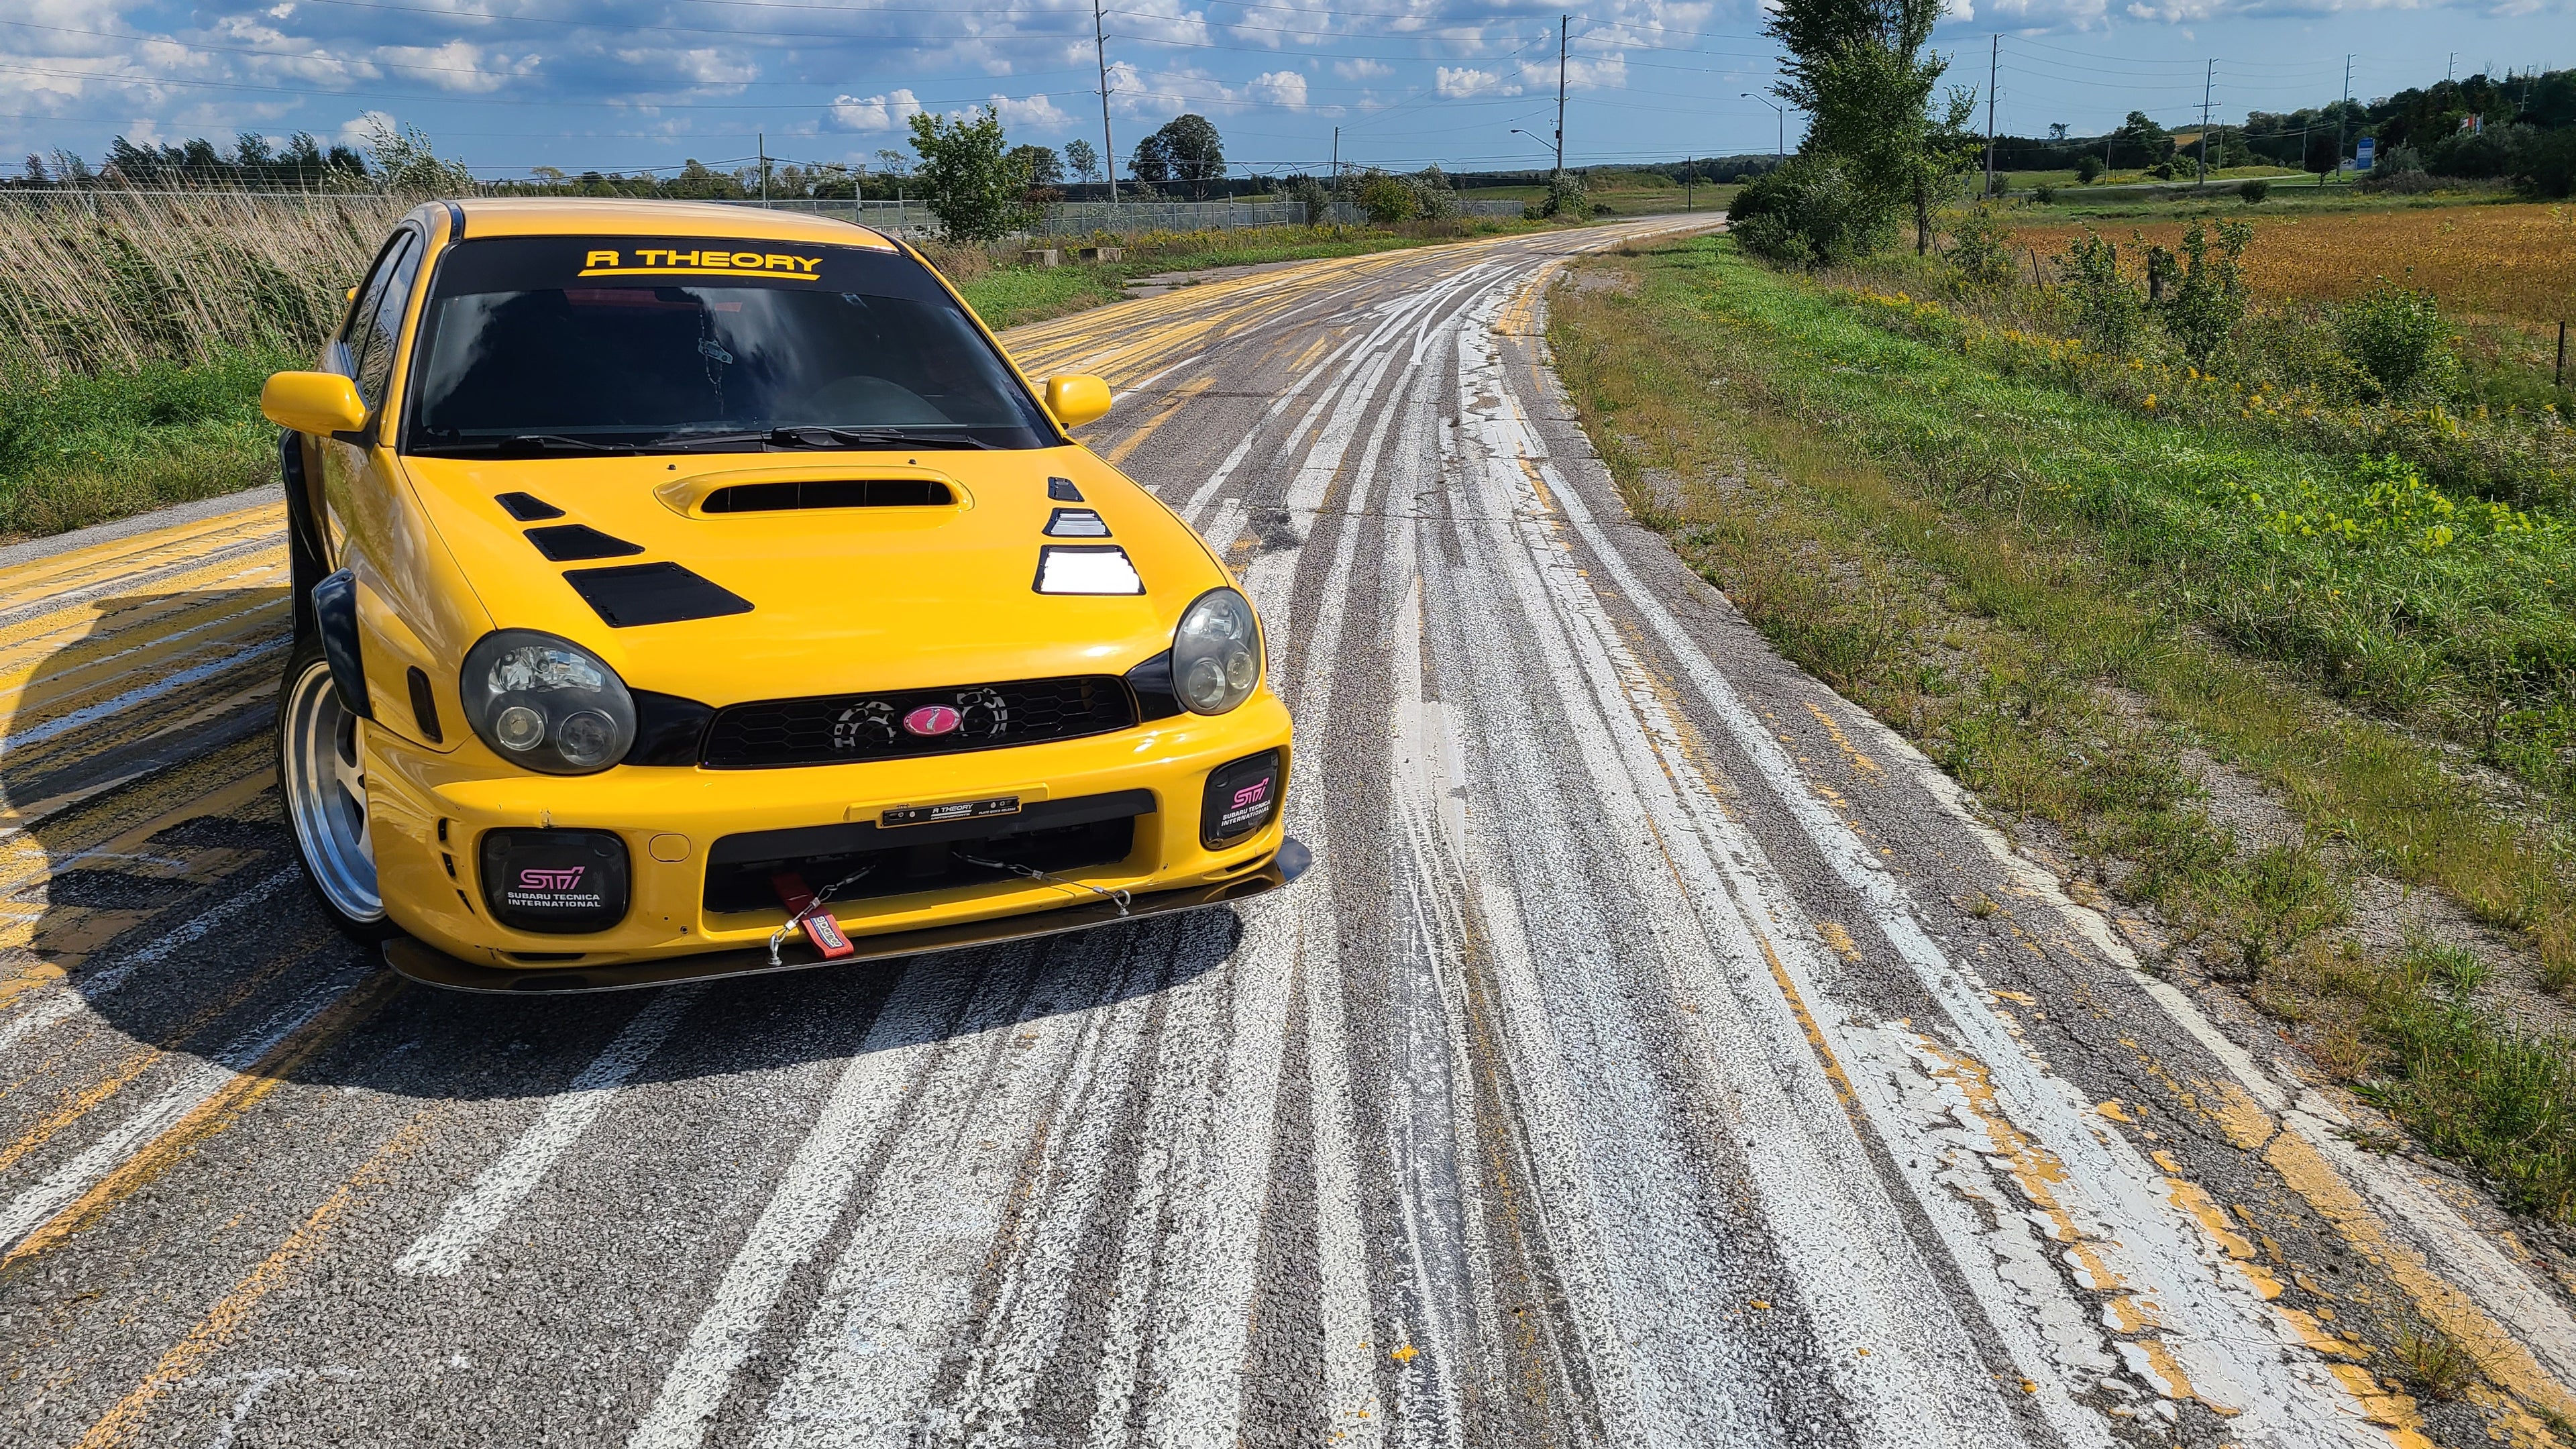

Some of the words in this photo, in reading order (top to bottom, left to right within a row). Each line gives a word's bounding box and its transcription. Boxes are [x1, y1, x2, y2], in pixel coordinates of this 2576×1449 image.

[586, 250, 620, 267] R
[635, 250, 824, 272] THEORY
[941, 804, 974, 812] THEORY
[1222, 808, 1248, 820] SUBARU
[1248, 799, 1271, 813] TECNICA
[930, 812, 971, 820] MOTORSPORTS
[1221, 806, 1270, 827] INTERNATIONAL
[508, 892, 551, 900] SUBARU
[508, 898, 601, 908] INTERNATIONAL
[813, 916, 843, 947] sparco
